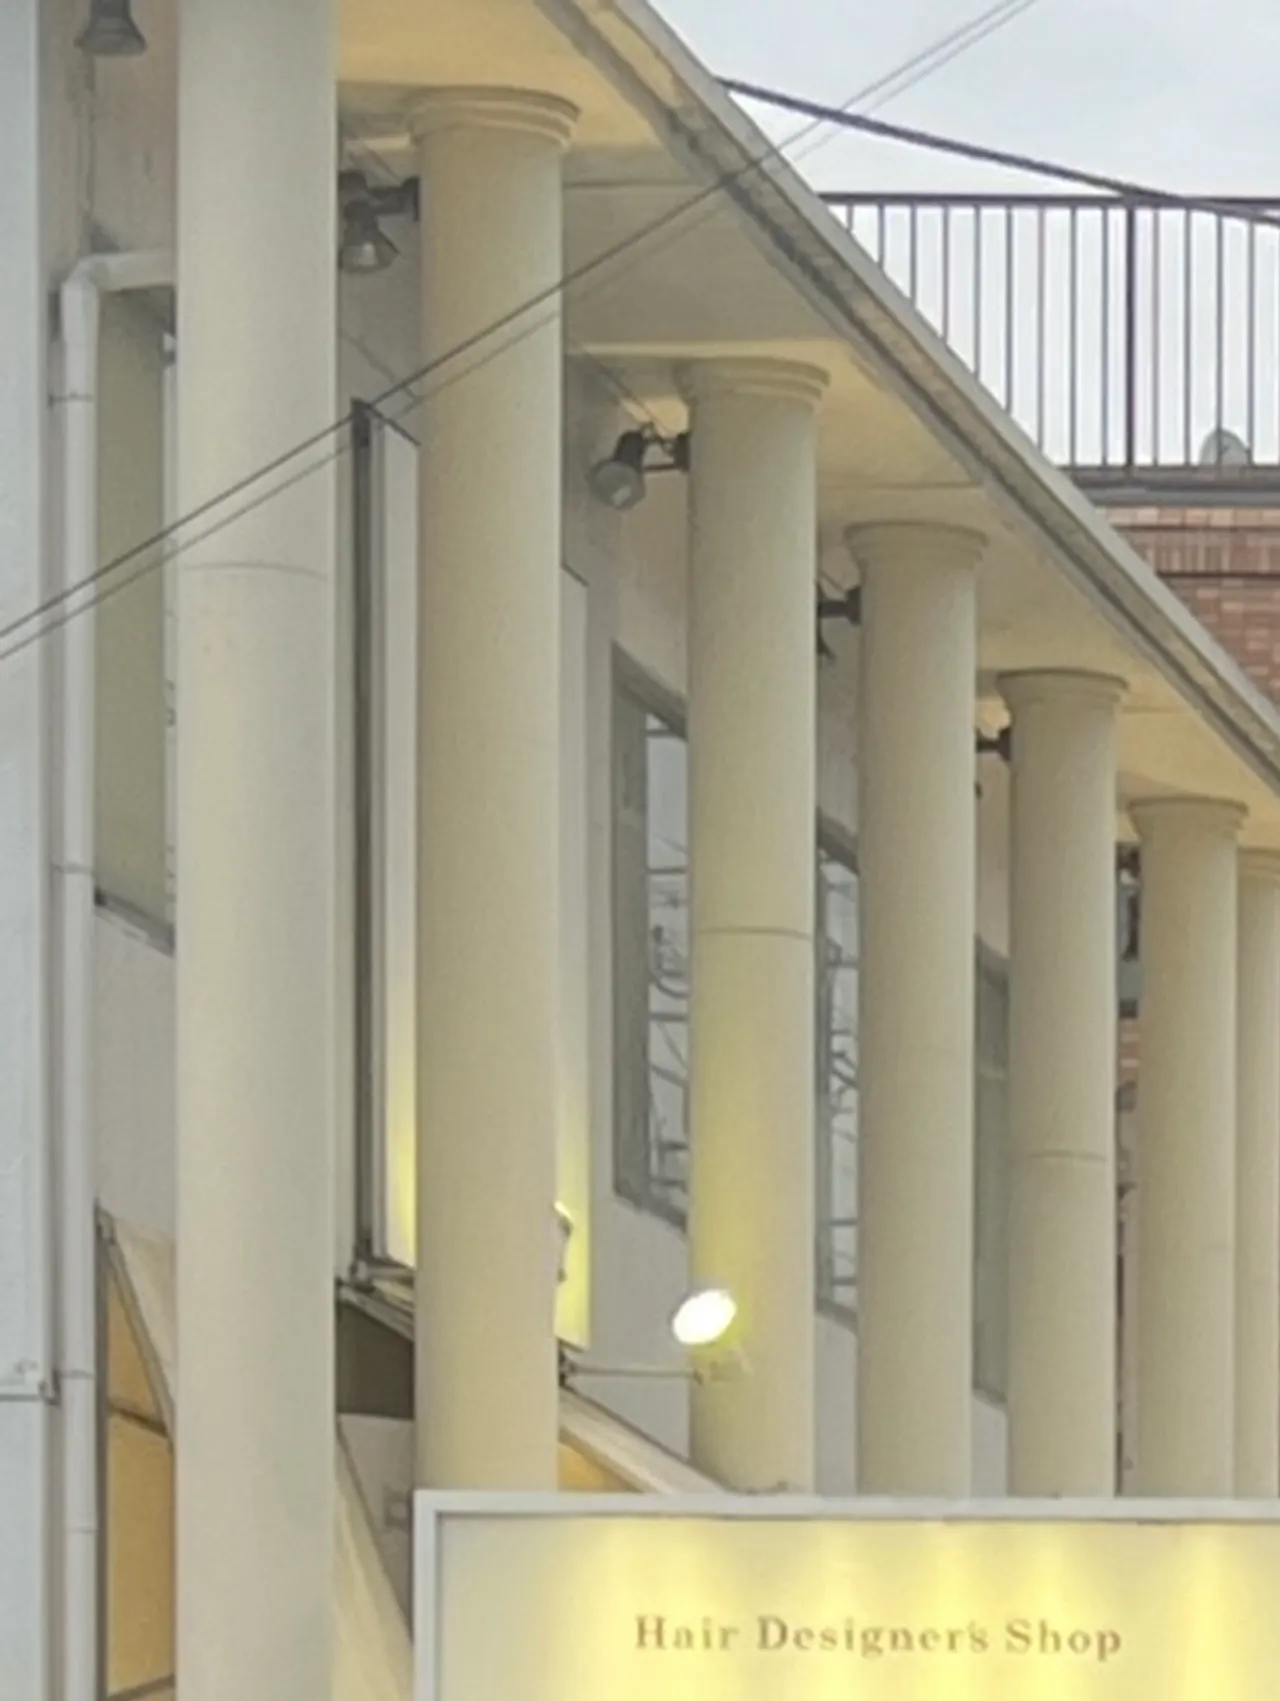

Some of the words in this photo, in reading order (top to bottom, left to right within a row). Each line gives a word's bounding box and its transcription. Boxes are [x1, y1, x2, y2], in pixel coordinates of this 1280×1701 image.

[634, 1614, 740, 1653] Hair
[756, 1615, 990, 1660] Designer's
[1004, 1618, 1123, 1662] Shop
